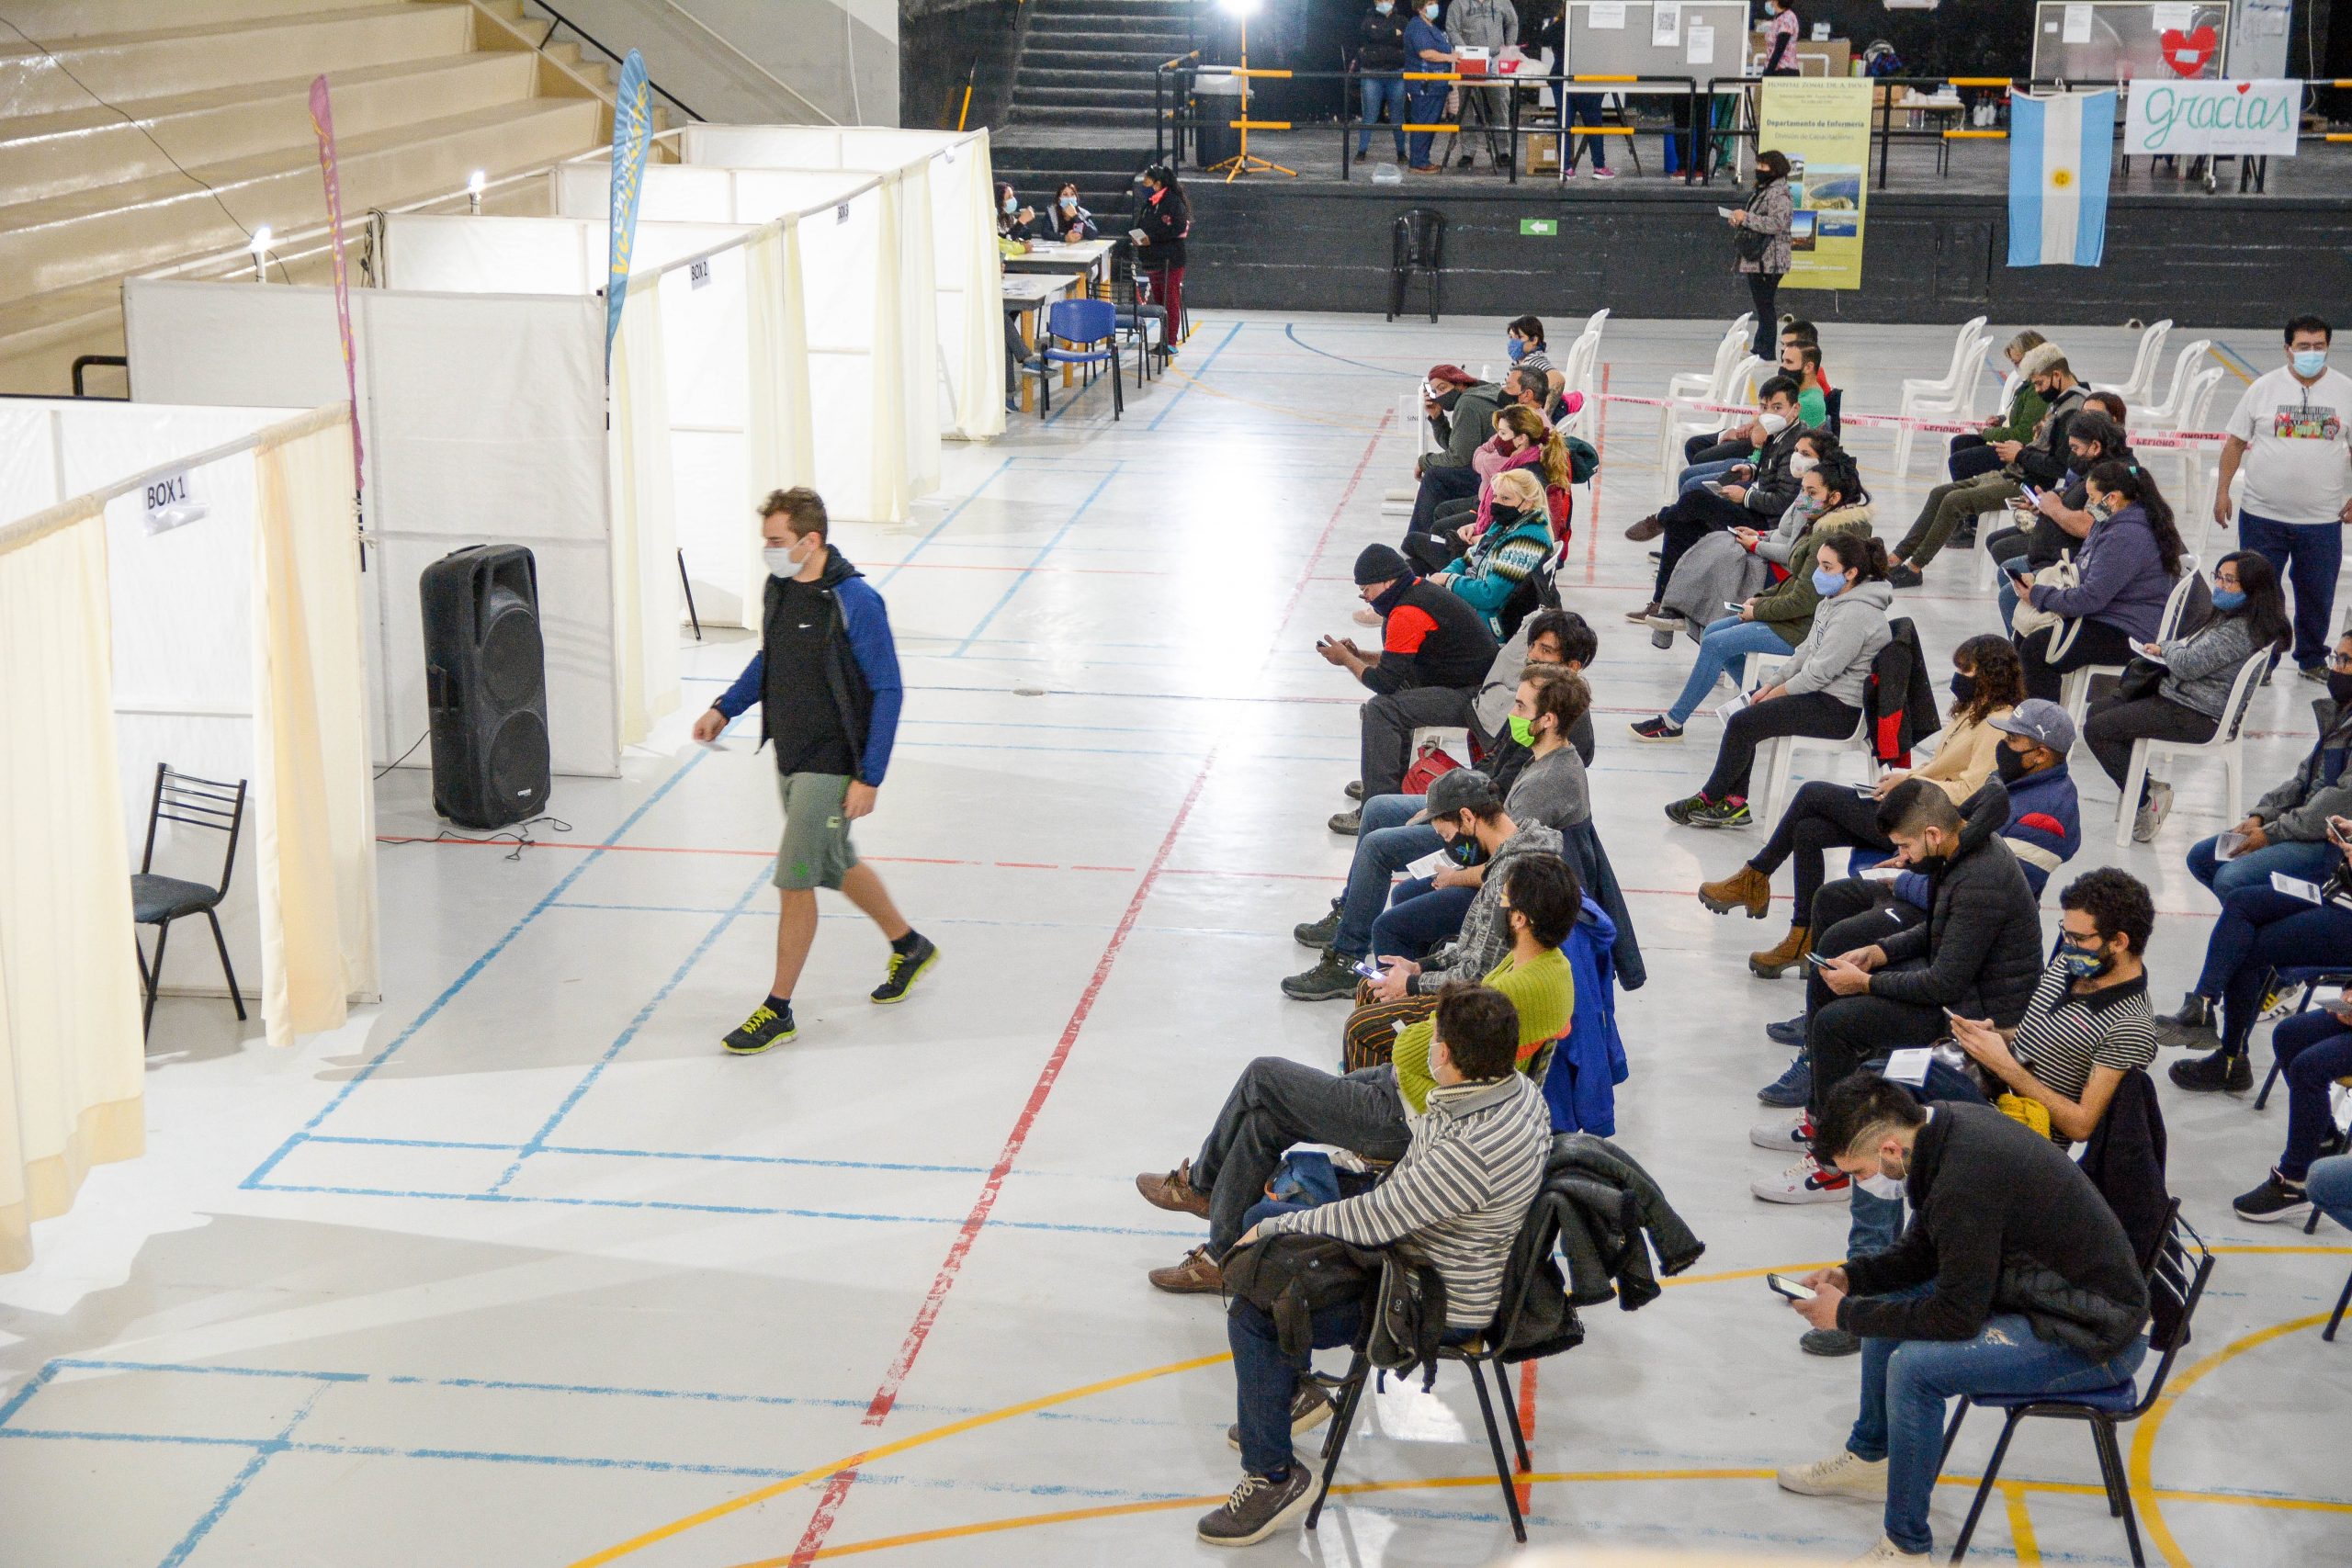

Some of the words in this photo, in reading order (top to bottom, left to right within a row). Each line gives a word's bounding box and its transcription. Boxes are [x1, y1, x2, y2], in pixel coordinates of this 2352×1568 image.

[1766, 118, 1815, 129] Departamento
[1817, 119, 1826, 128] de
[692, 263, 704, 281] BOX
[147, 479, 175, 510] BOX
[177, 476, 186, 499] 1
